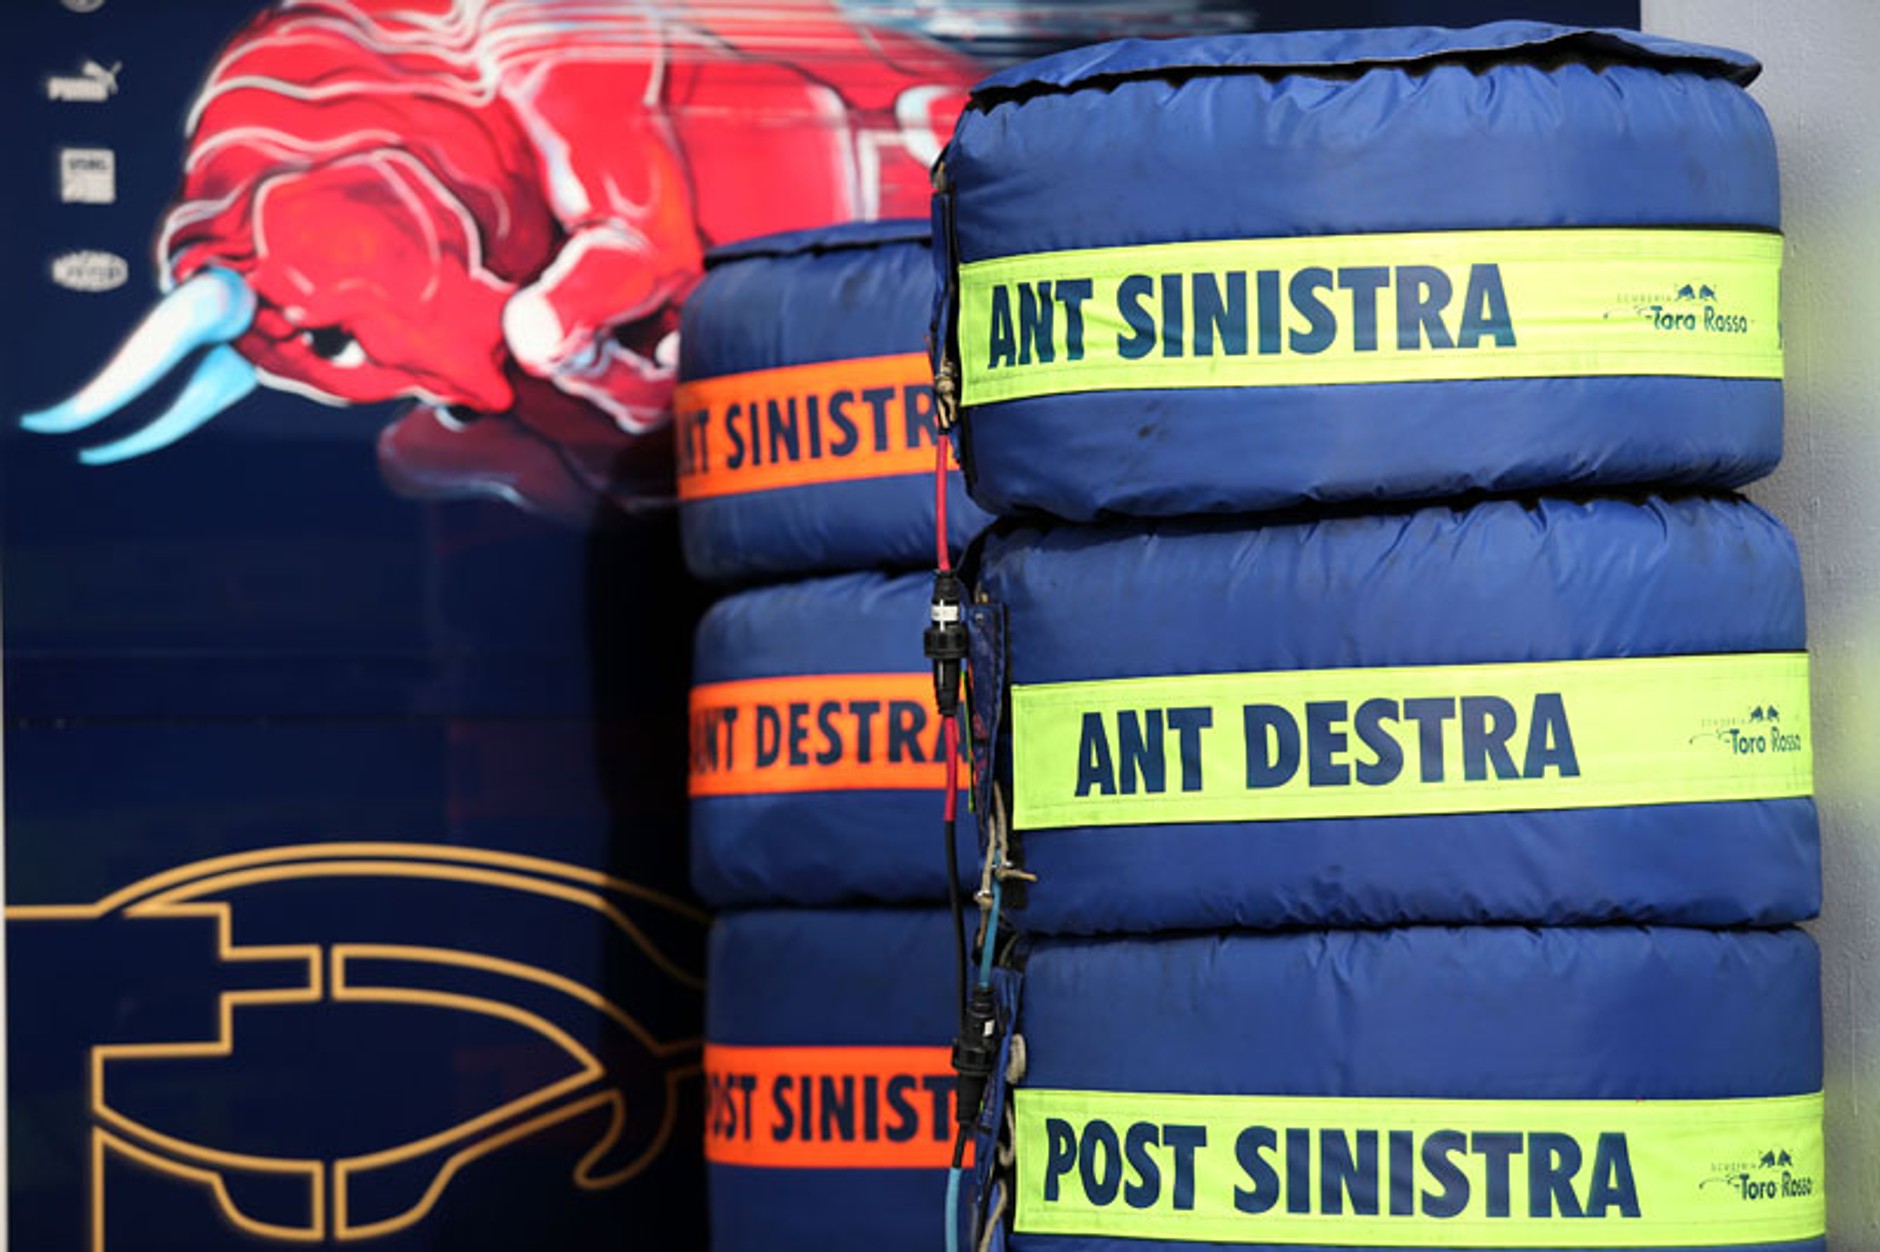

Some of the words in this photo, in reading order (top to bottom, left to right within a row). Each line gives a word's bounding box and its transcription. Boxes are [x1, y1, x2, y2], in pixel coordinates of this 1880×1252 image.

[987, 277, 1094, 370] ANT
[1116, 262, 1517, 360] SINISTRA
[725, 383, 942, 470] SINISTR
[1073, 706, 1214, 798] ANT
[1242, 692, 1581, 790] DESTRA
[1729, 727, 1767, 755] Toro
[771, 1073, 964, 1143] SINIST
[1043, 1117, 1208, 1211] POST
[1233, 1125, 1642, 1219] SINISTRA
[1738, 1172, 1778, 1201] Toro
